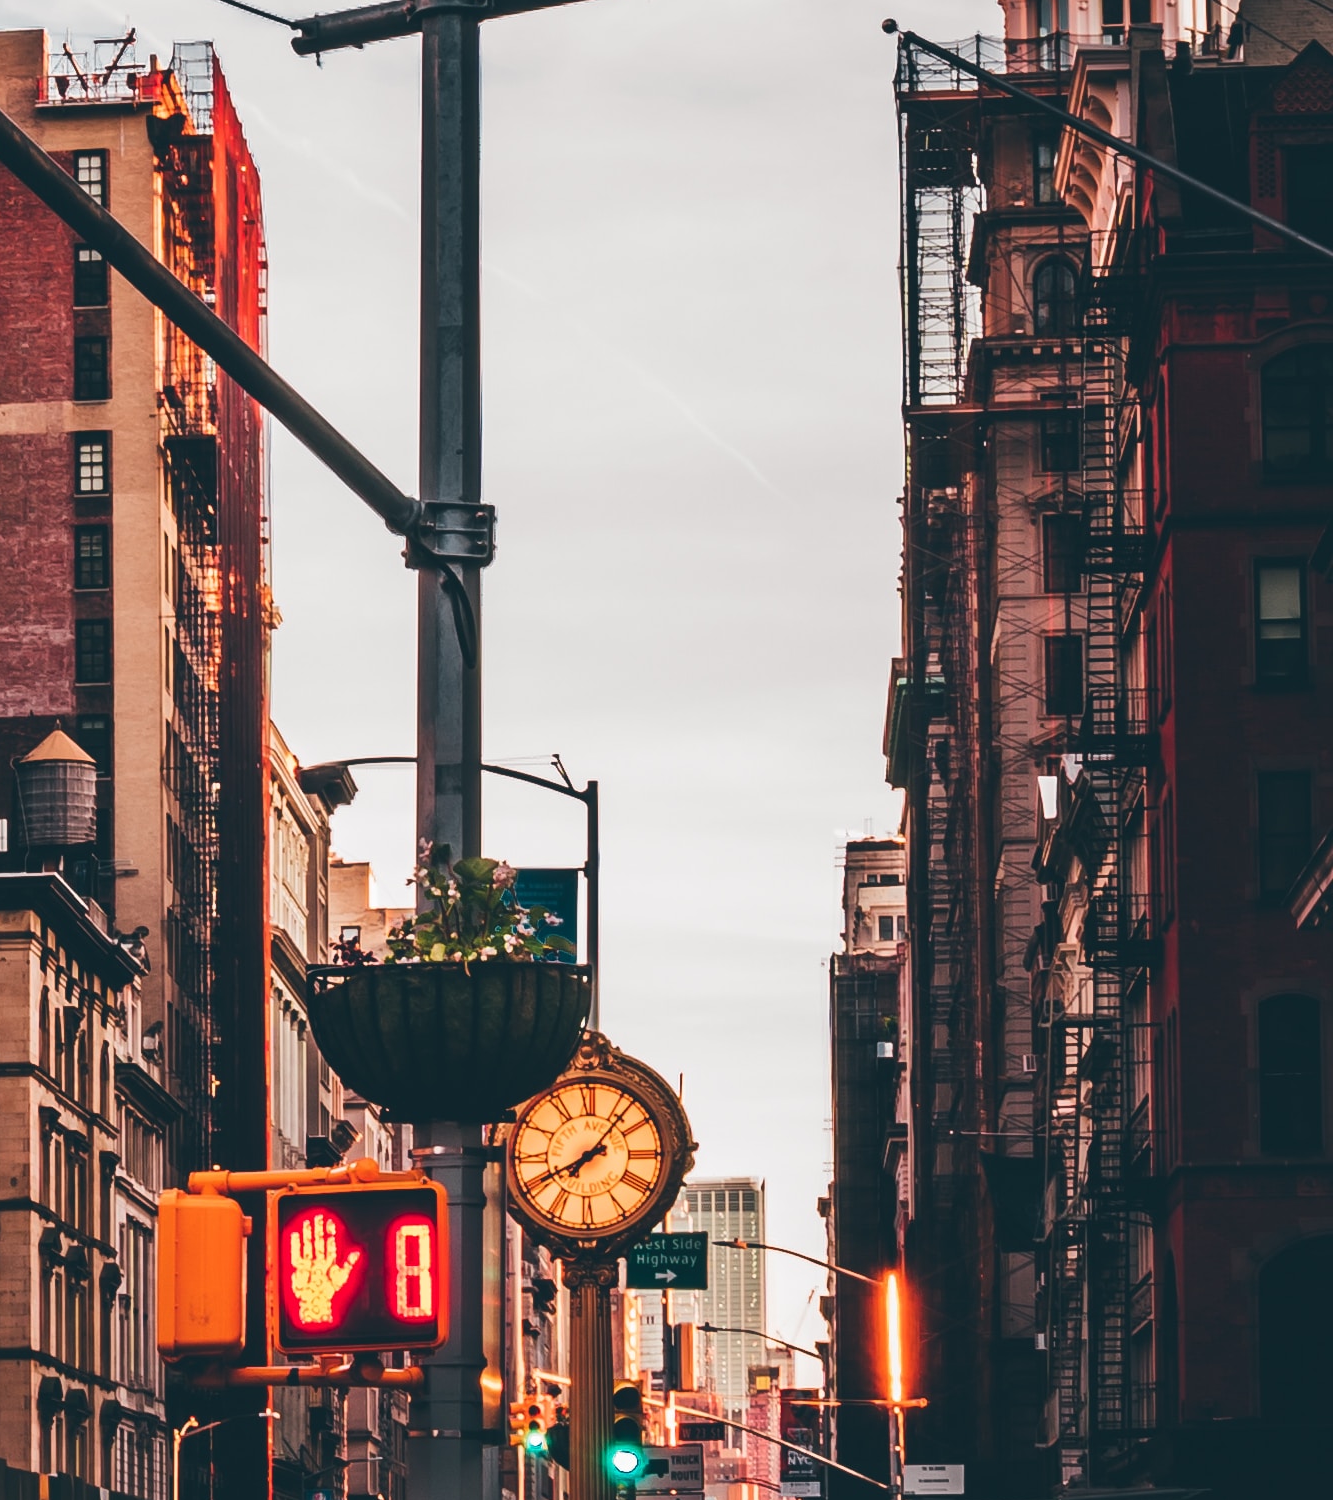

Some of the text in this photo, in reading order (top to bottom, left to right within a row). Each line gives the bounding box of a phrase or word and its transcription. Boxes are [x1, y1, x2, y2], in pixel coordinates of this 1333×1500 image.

[551, 1124, 580, 1157] FIFTH
[672, 1238, 702, 1250] Side
[636, 1253, 697, 1268] Highway
[682, 1427, 691, 1439] W
[696, 1427, 708, 1439] 23
[670, 1455, 700, 1465] TRUCK
[670, 1470, 700, 1481] ROUTE
